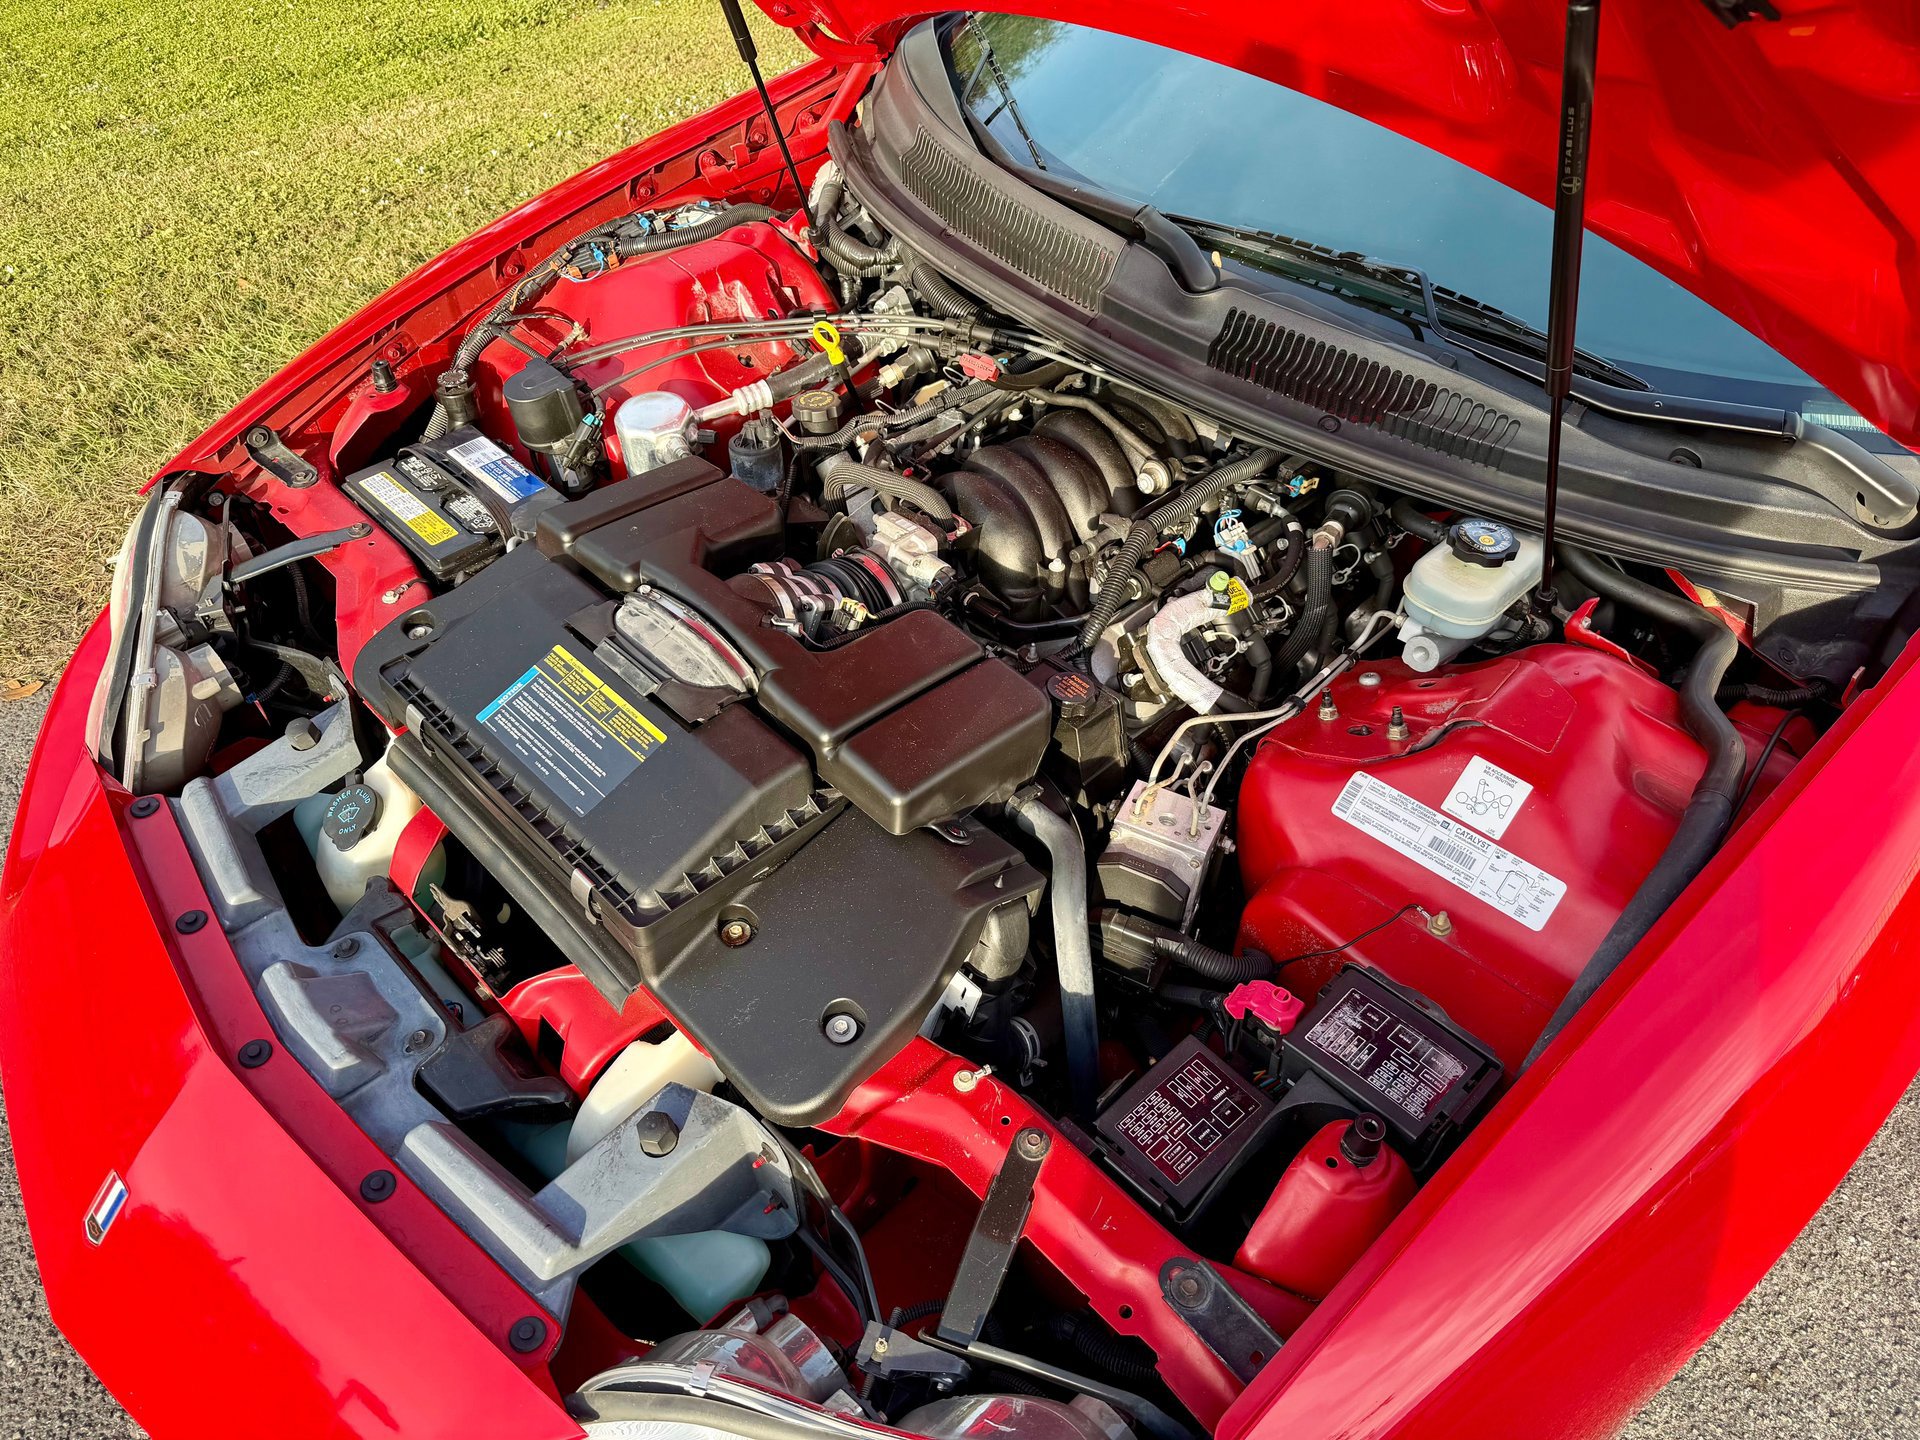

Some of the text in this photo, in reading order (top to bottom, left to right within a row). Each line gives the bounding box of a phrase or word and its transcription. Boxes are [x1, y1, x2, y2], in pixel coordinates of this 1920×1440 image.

[1564, 106, 1574, 174] STABILUS
[497, 681, 523, 705] NOTICE
[1483, 769, 1515, 789] BELT ROUTING
[1491, 768, 1518, 785] ACCESSORY
[326, 788, 371, 816] WASHER FLUID
[1388, 793, 1410, 808] CONTROL
[1409, 805, 1441, 825] INFORMATION
[1396, 793, 1416, 806] VEHICLE
[1415, 803, 1437, 817] EMISSION
[338, 823, 356, 834] ONLY
[1454, 827, 1491, 850] CATALYST
[1422, 1072, 1443, 1088] FOG LAMP
[1177, 1122, 1186, 1131] PUMP
[1198, 1128, 1211, 1140] STARTER
[1177, 1155, 1193, 1170] FUEL PUMP
